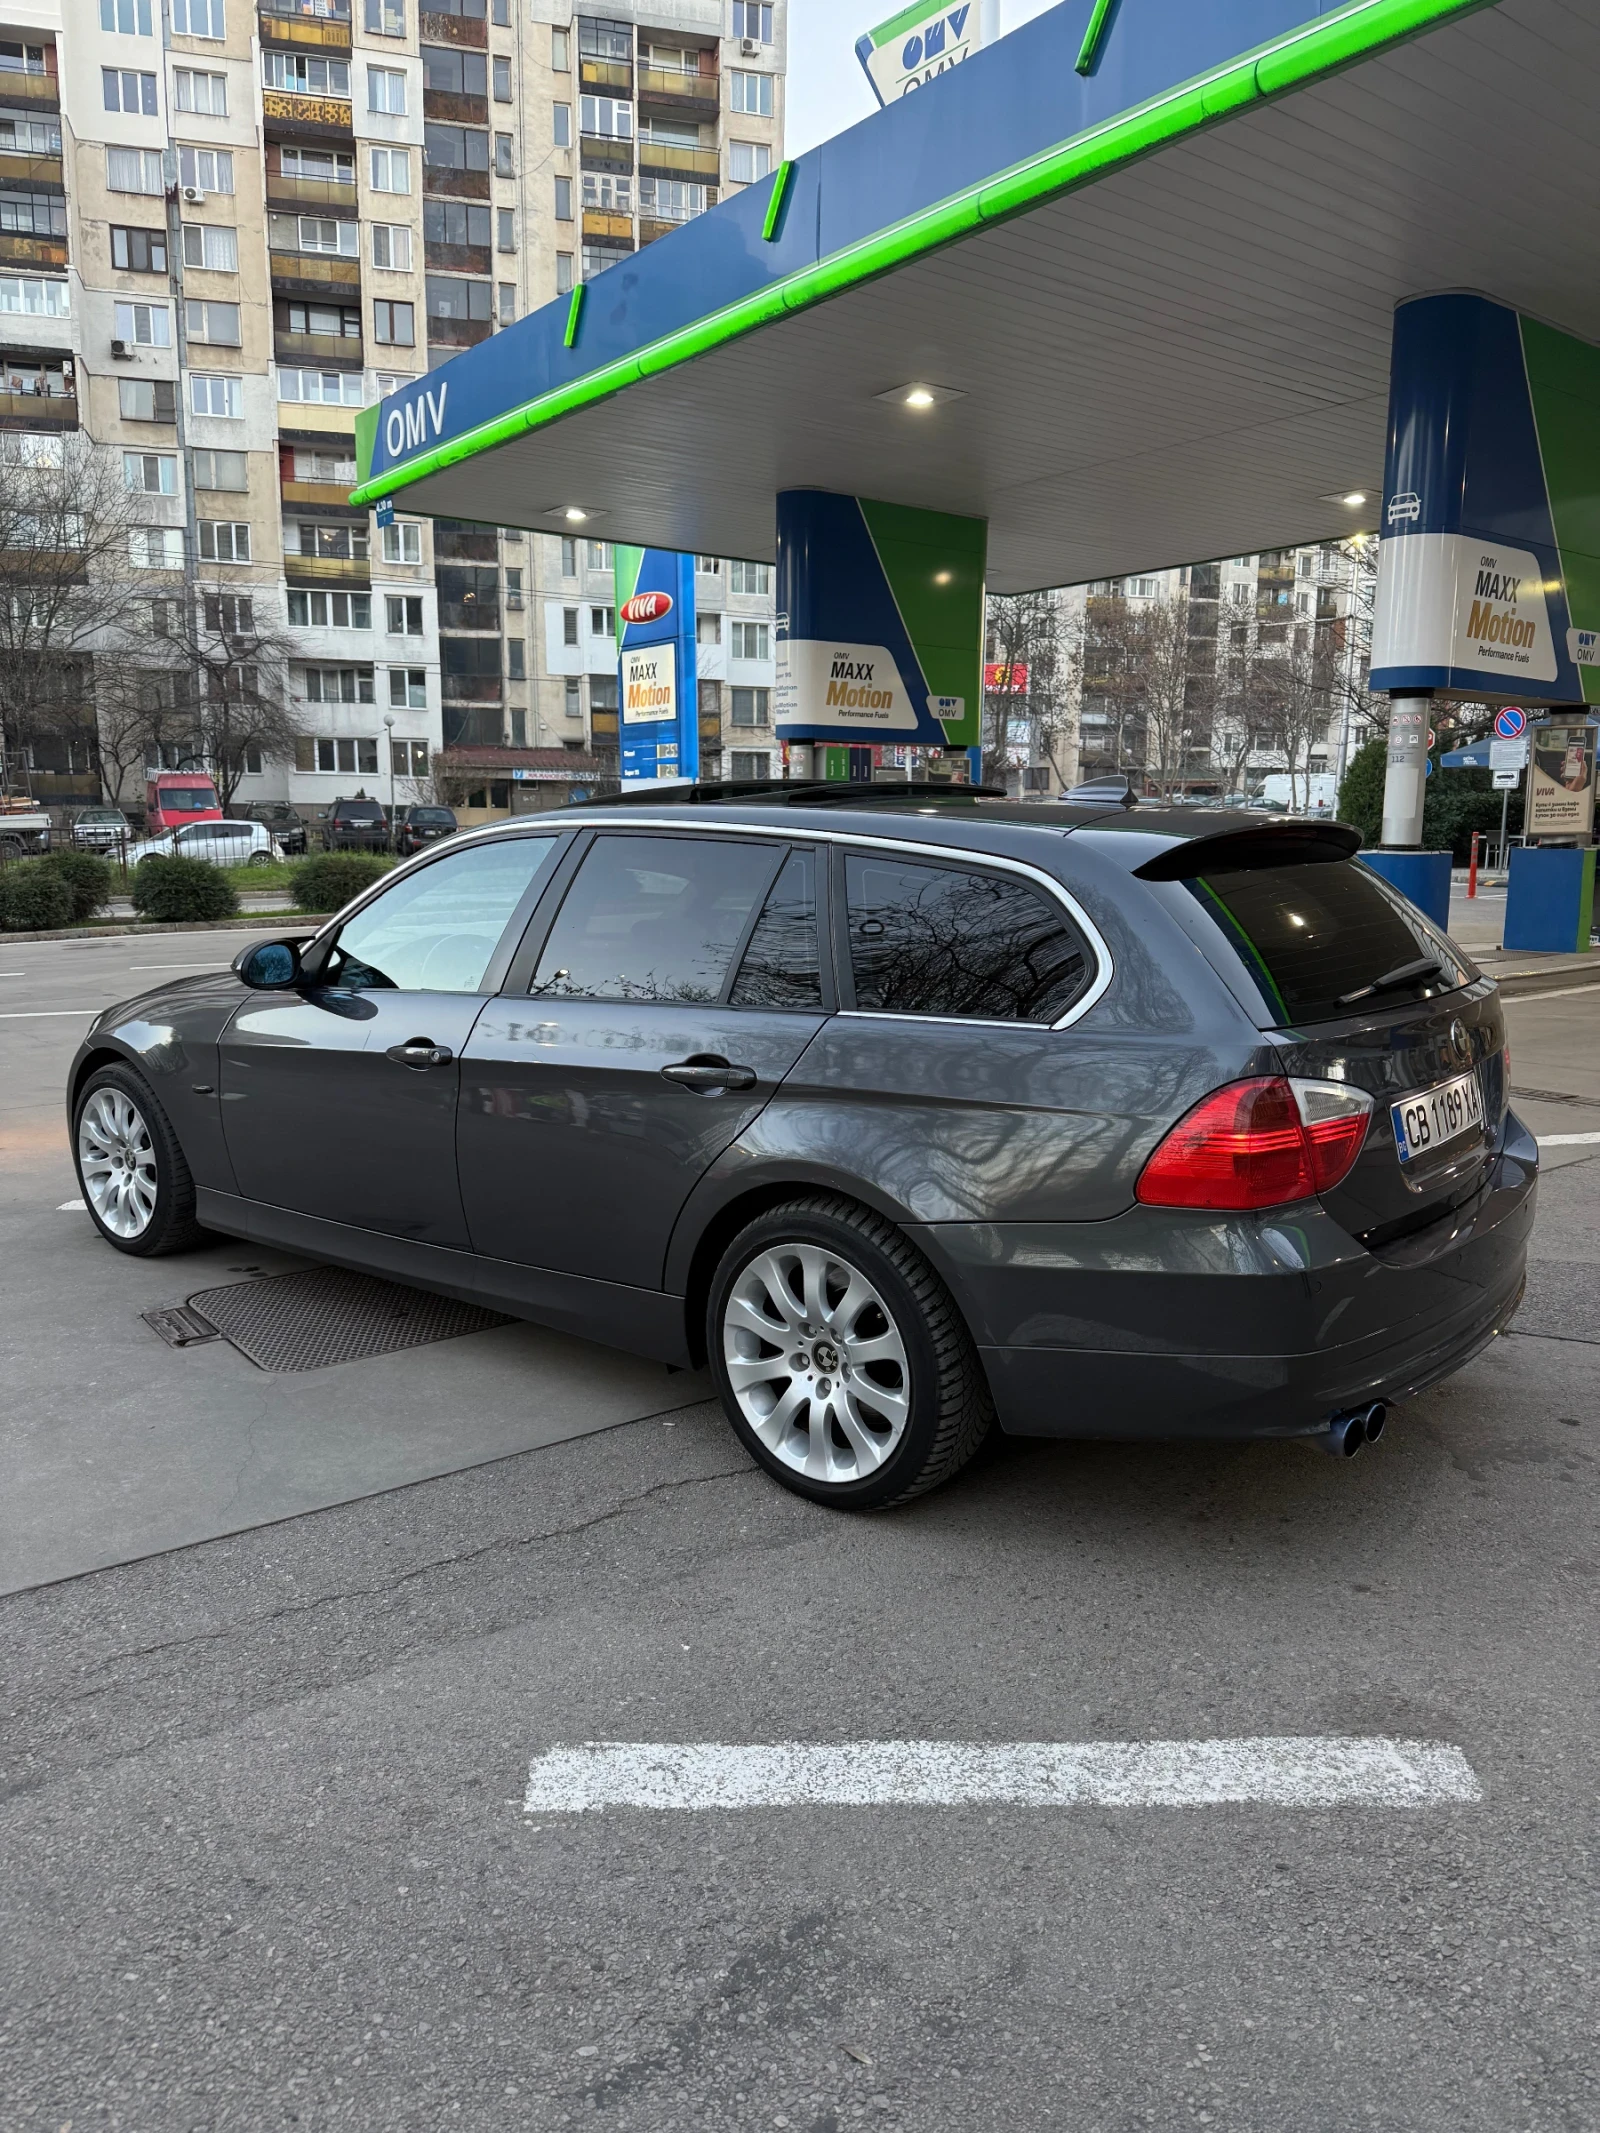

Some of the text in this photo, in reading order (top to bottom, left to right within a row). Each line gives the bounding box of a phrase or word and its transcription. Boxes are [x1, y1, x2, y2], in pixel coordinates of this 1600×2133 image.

[902, 2, 971, 70] OMV
[386, 381, 448, 457] OMV
[1480, 556, 1498, 569] OMV
[1474, 570, 1521, 603] MAXX
[628, 595, 657, 620] VIVA
[1466, 600, 1536, 648] Motion
[1578, 632, 1597, 646] OMV
[833, 652, 850, 660] OMV
[1478, 646, 1530, 663] Performance Fuels
[1577, 648, 1595, 662] OMV
[629, 662, 657, 682] MAXX
[830, 661, 875, 681] MAXX
[628, 681, 671, 709] Motion
[826, 681, 893, 709] Motion
[838, 709, 889, 719] Performance Fuels
[938, 709, 957, 717] OMV
[1391, 755, 1405, 763] 112
[1536, 788, 1555, 796] VIVA
[1405, 1078, 1480, 1149] CB 1189 XA
